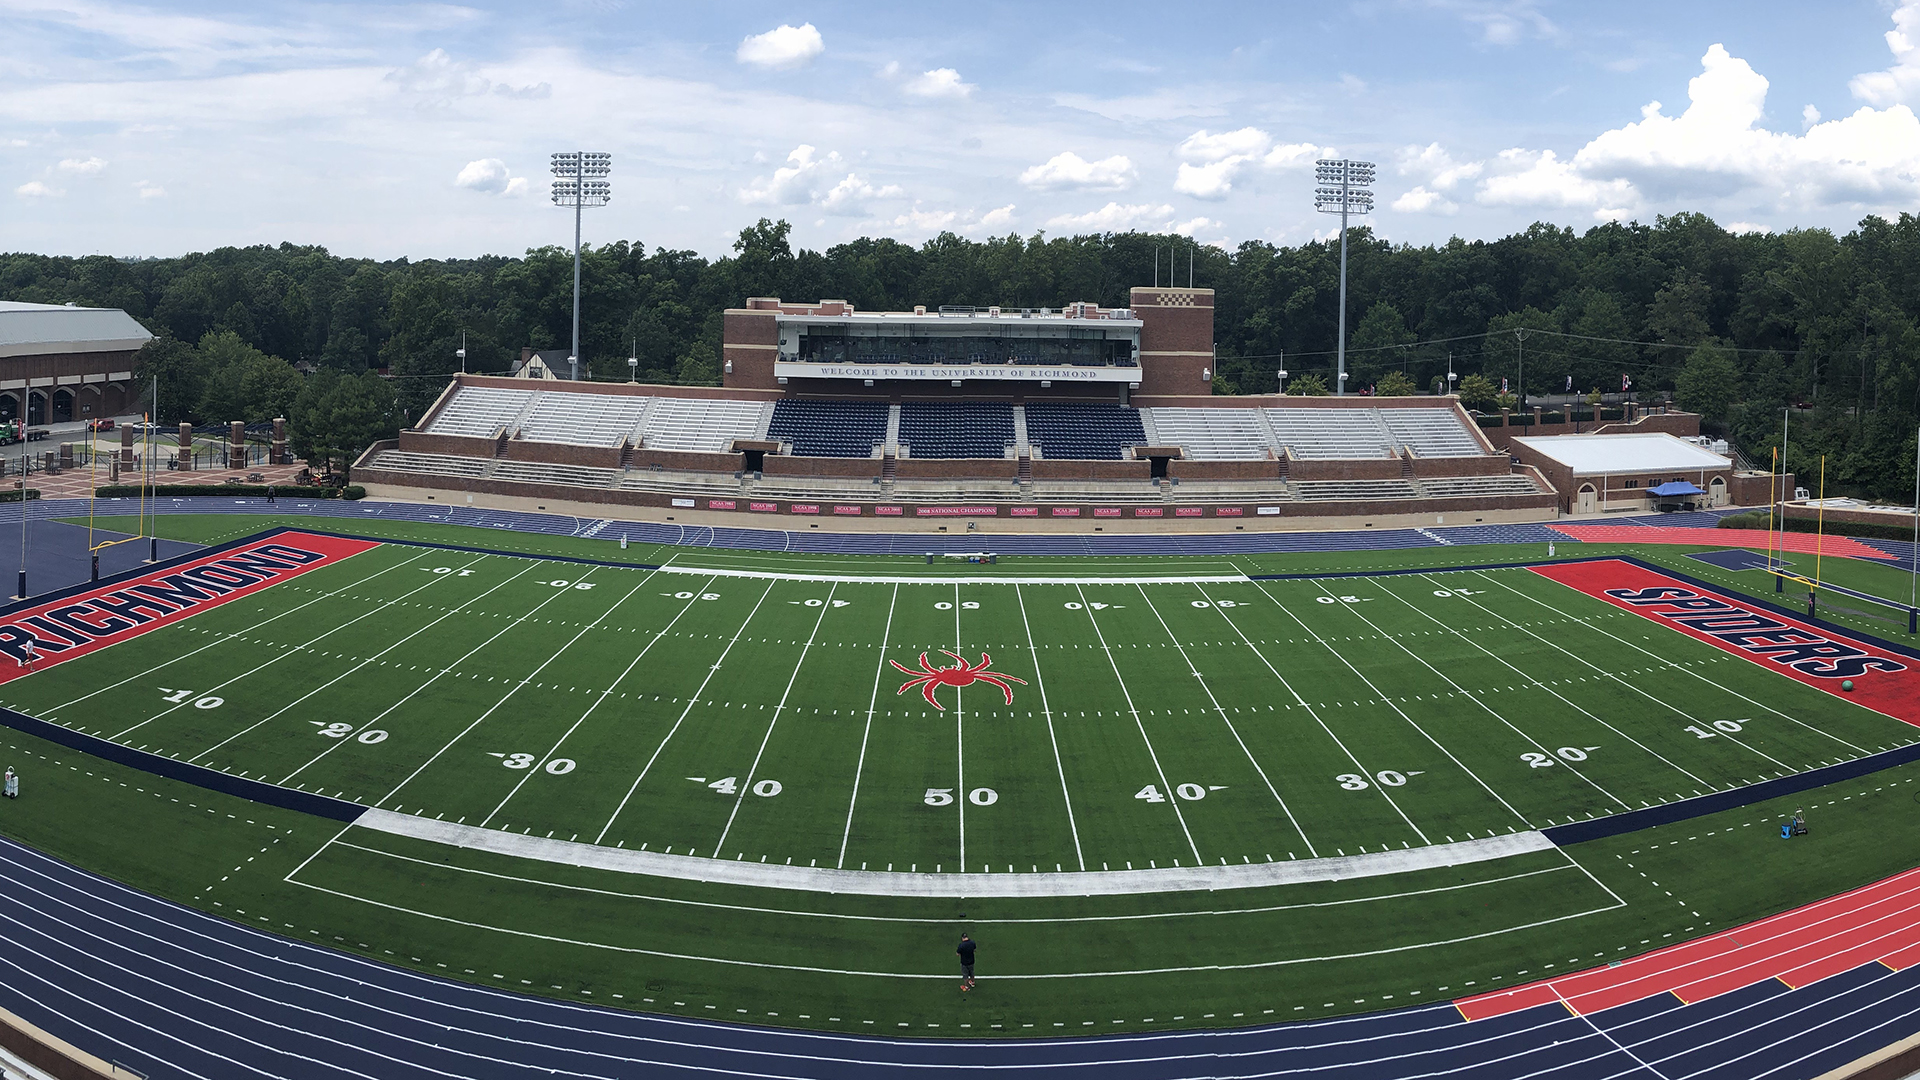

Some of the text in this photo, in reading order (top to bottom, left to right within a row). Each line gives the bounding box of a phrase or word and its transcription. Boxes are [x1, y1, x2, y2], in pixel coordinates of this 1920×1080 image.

[821, 368, 878, 376] WELCOME
[904, 369, 926, 377] THE
[932, 369, 1005, 377] UNIVERSITY
[1030, 370, 1097, 378] RICHMOND
[432, 566, 476, 577] 10
[549, 579, 597, 591] 20
[1432, 587, 1474, 598] 10
[674, 591, 721, 601] 30
[803, 599, 852, 608] 40
[933, 600, 981, 610] 50
[1190, 600, 1237, 609] 30
[1315, 595, 1361, 604] 20
[0, 544, 328, 667] RICHMOND
[1063, 601, 1110, 610] 40
[1604, 587, 1908, 678] SPIDERS
[161, 689, 225, 710] 10
[316, 722, 389, 745] 20
[1684, 718, 1743, 740] 10
[502, 753, 577, 775] 30
[1519, 746, 1588, 768] 20
[707, 777, 783, 798] 40
[1335, 770, 1407, 791] 30
[923, 788, 999, 806] 50
[1134, 783, 1206, 803] 40
